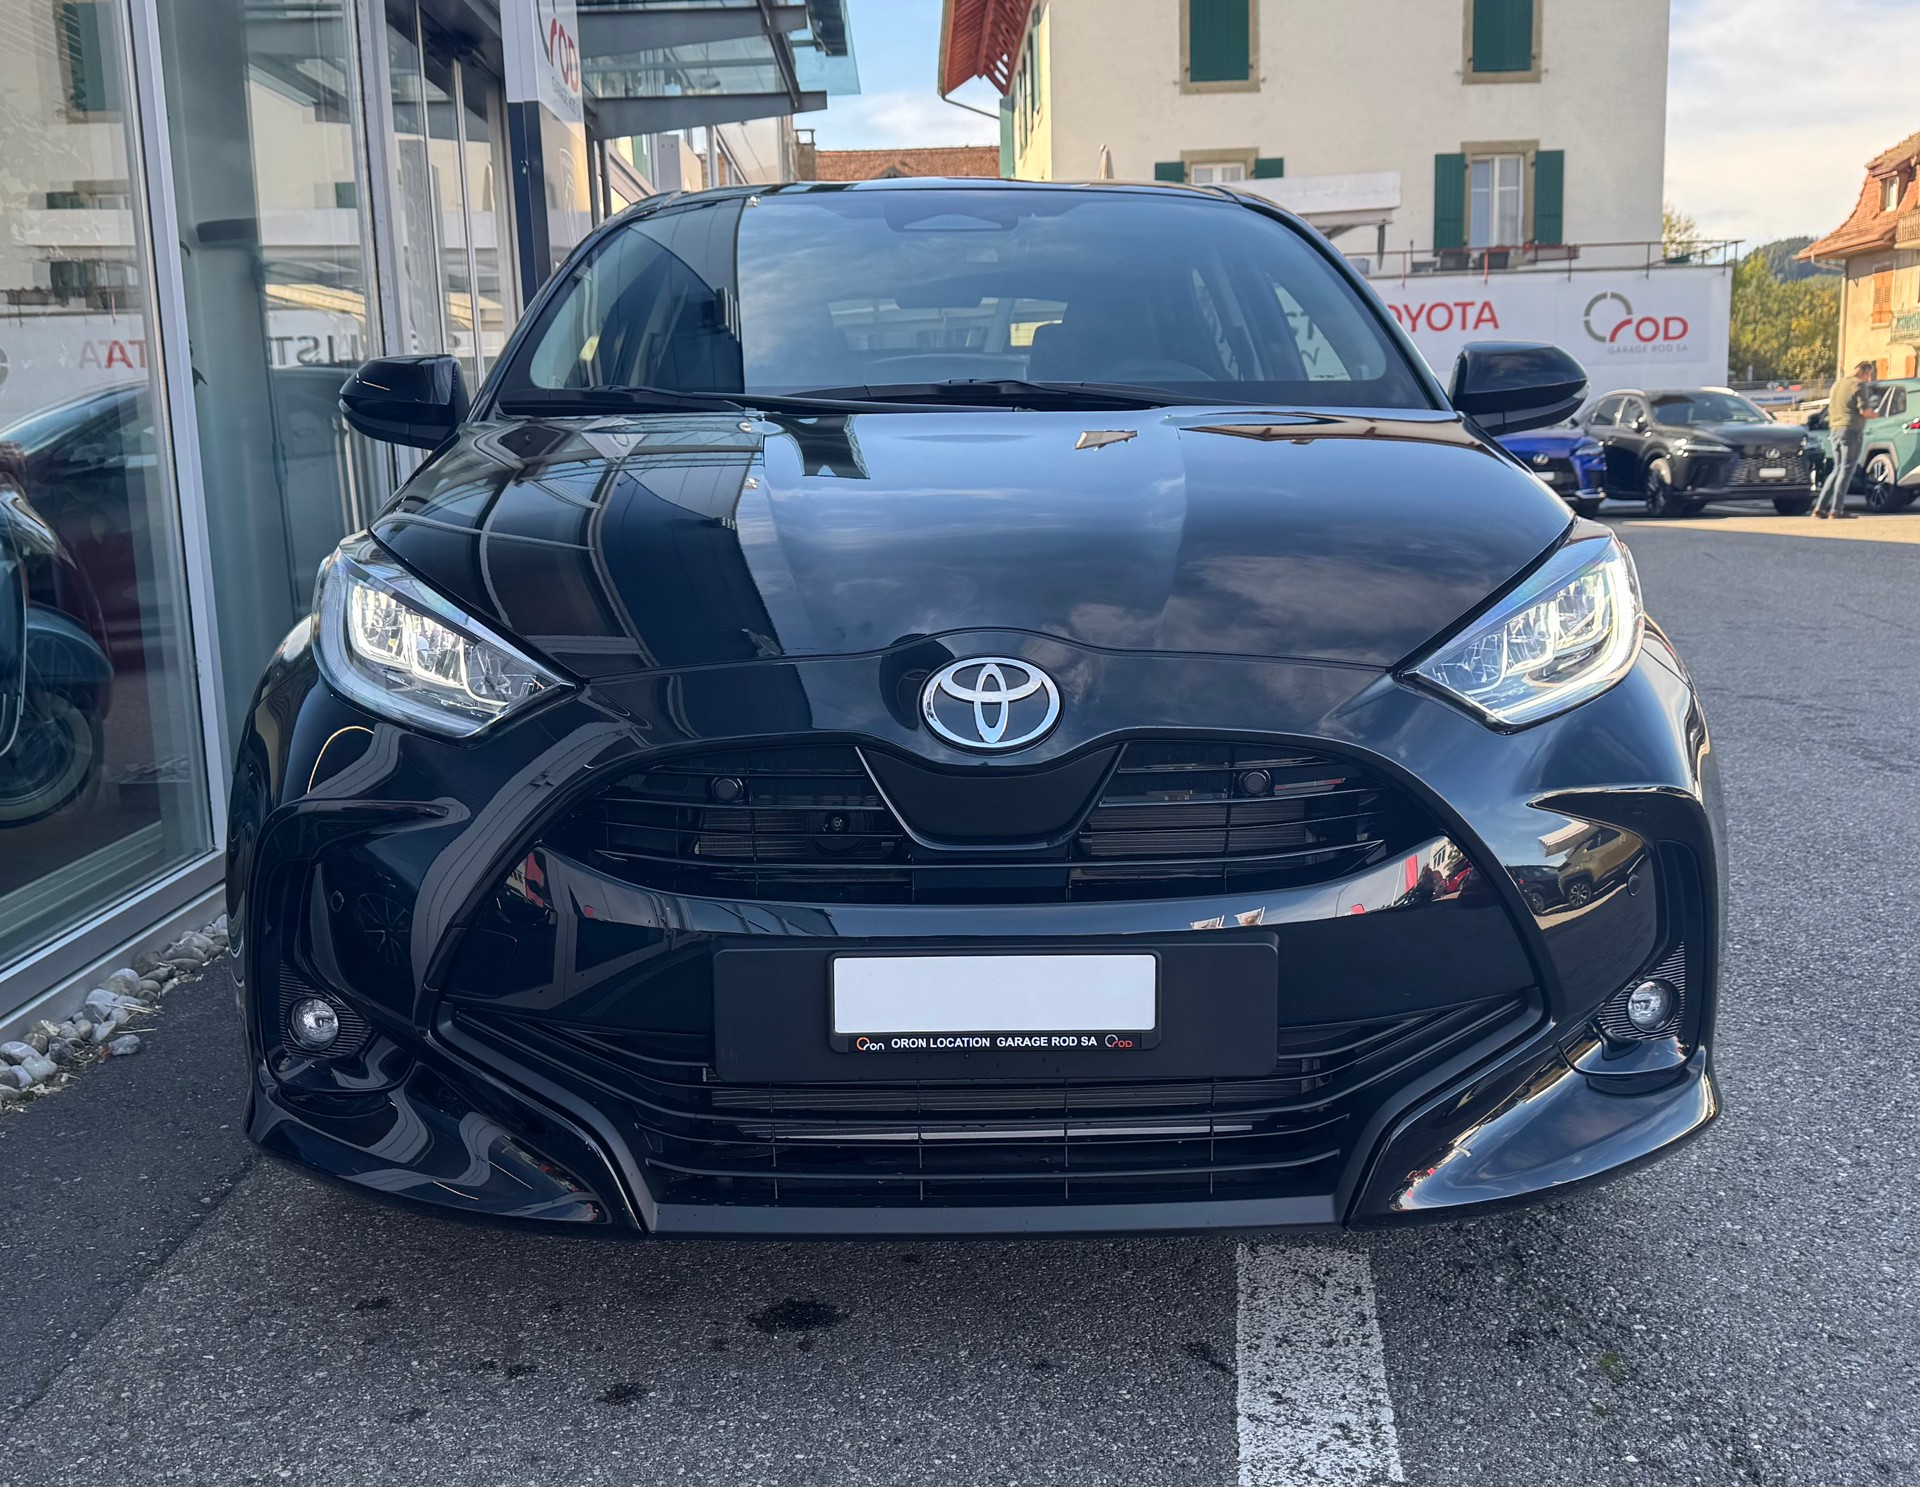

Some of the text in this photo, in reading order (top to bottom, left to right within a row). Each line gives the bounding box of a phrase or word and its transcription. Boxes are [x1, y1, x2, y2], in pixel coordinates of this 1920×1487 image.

[1608, 345, 1648, 354] GARAGE
[1651, 344, 1674, 353] ROD
[891, 1038, 926, 1048] ORON
[930, 1037, 990, 1048] LOCATION
[996, 1036, 1048, 1047] GARAGE
[1051, 1036, 1077, 1047] ROD
[1080, 1036, 1098, 1046] SA
